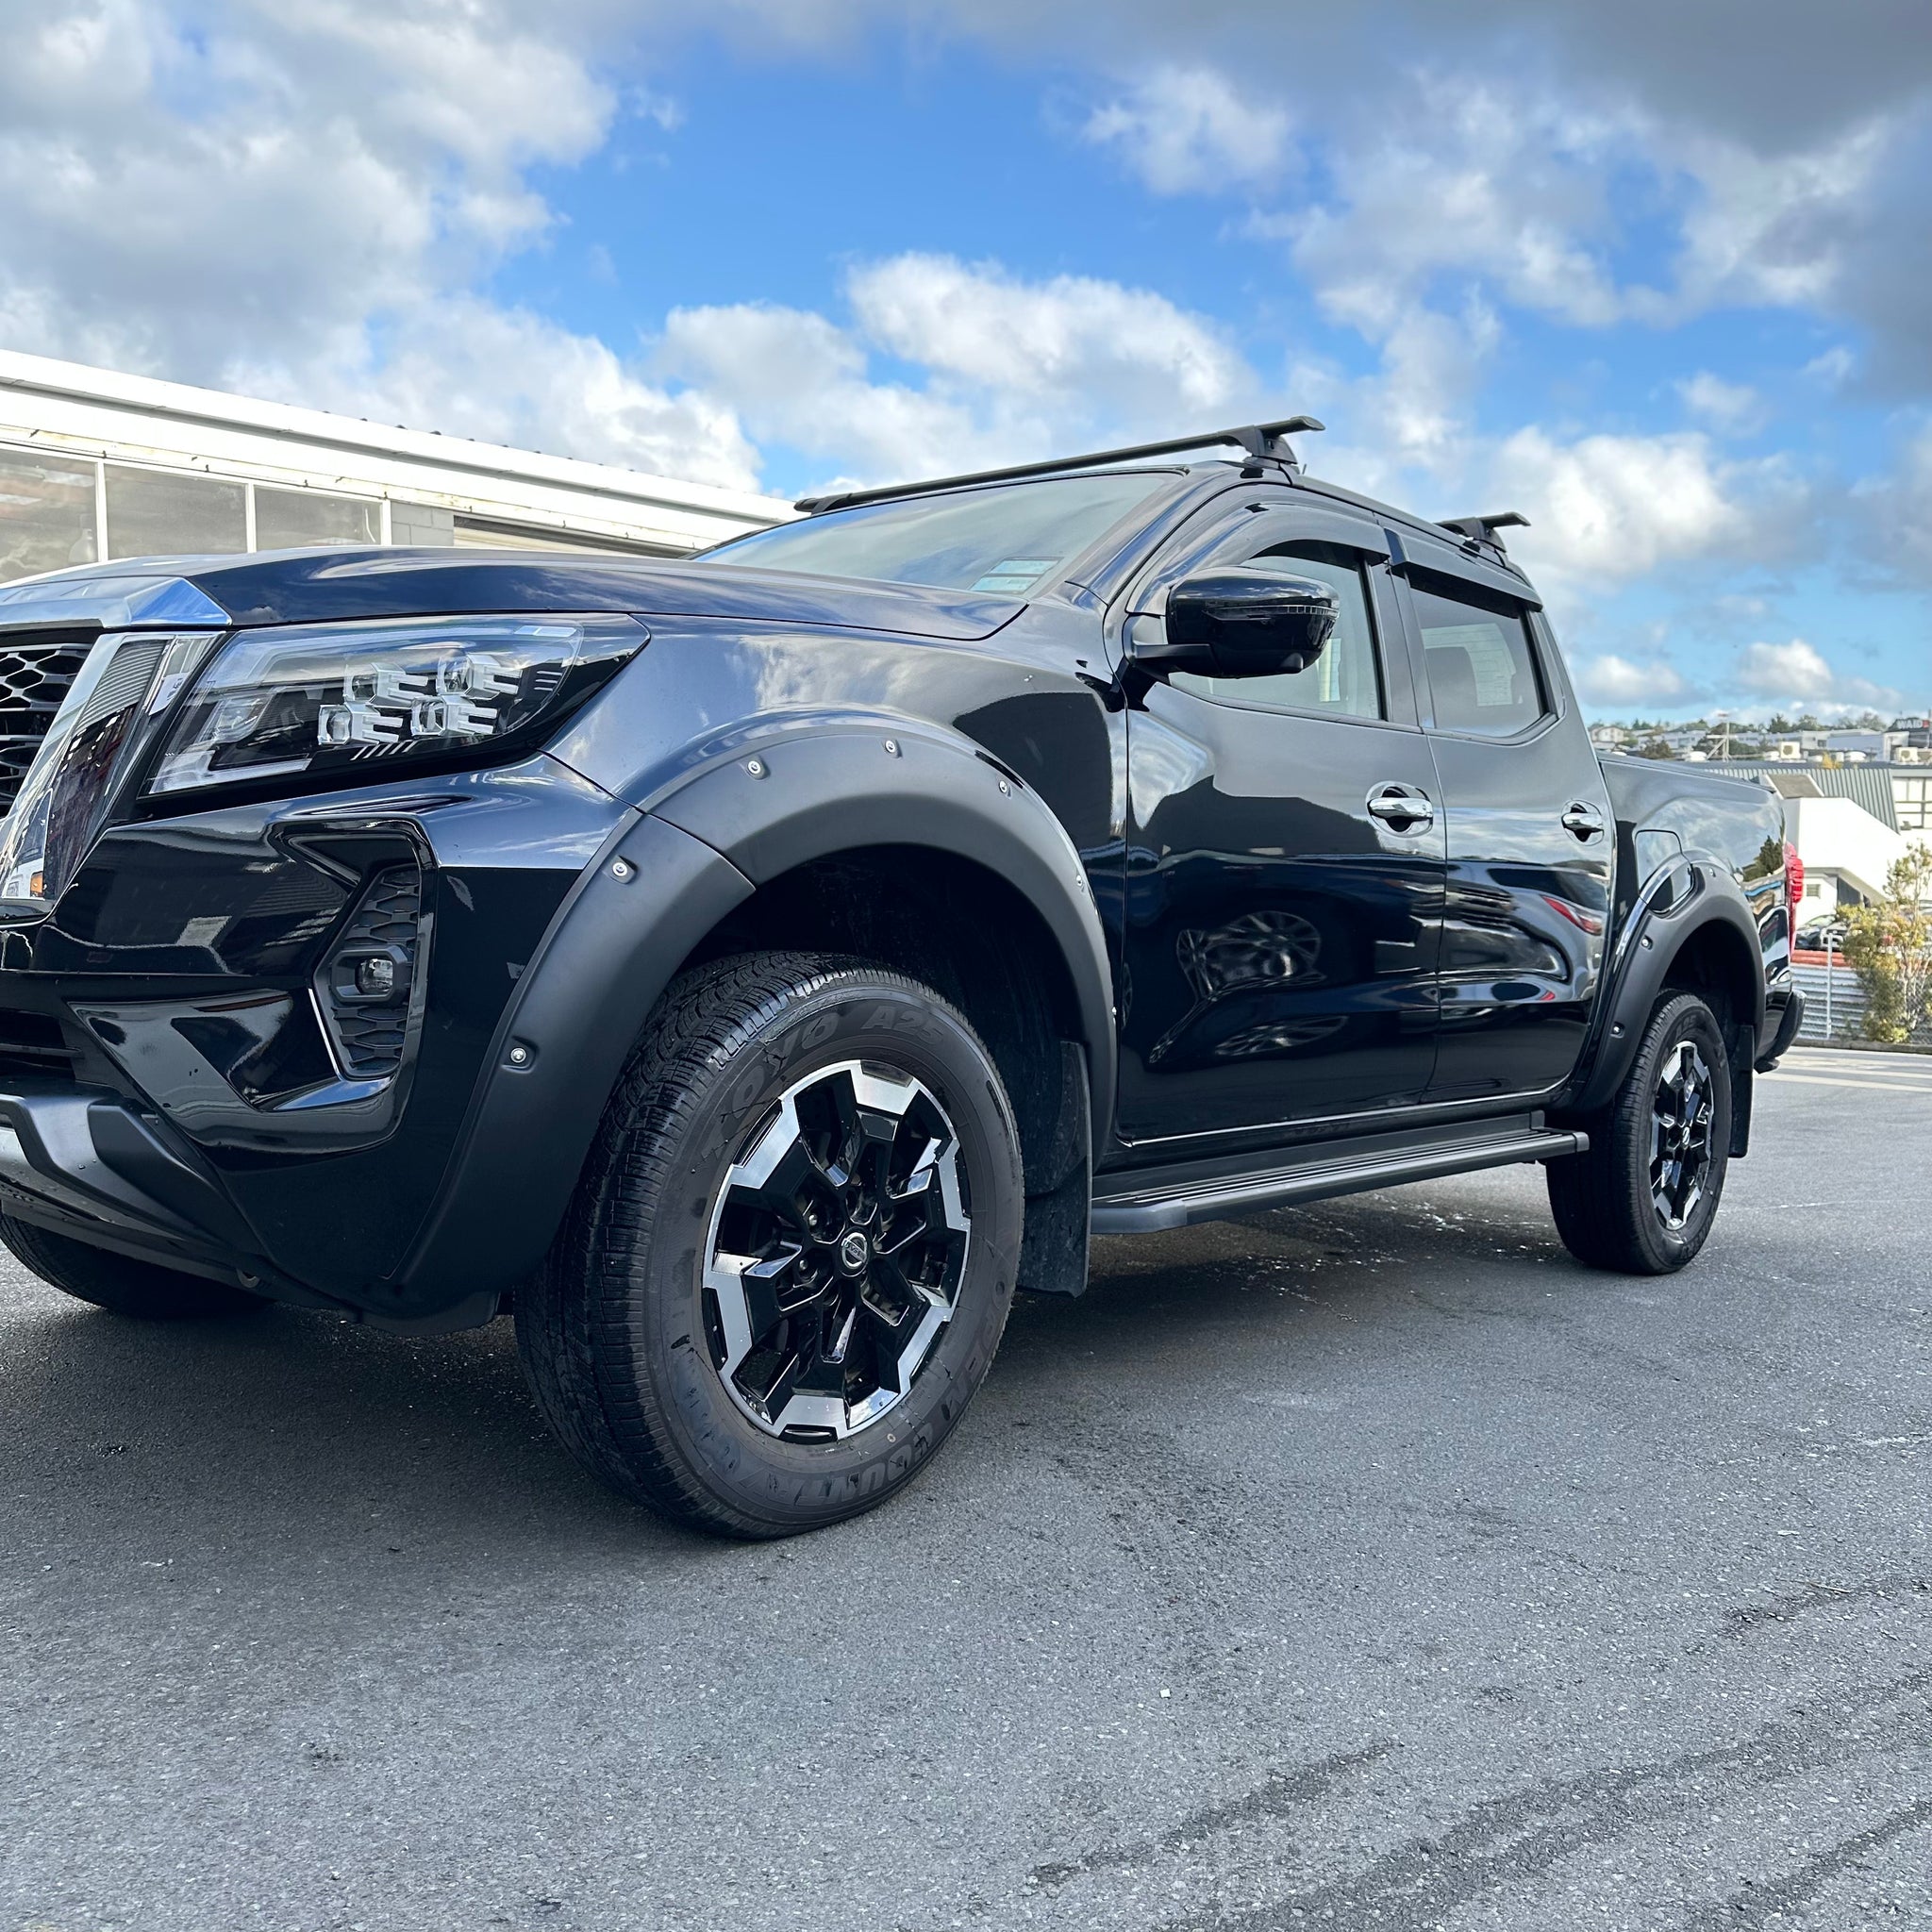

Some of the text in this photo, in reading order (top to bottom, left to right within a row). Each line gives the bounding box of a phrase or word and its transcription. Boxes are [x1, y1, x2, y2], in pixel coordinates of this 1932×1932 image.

[701, 1006, 943, 1163] TOYO A25
[738, 1422, 935, 1507] COUNTRY
